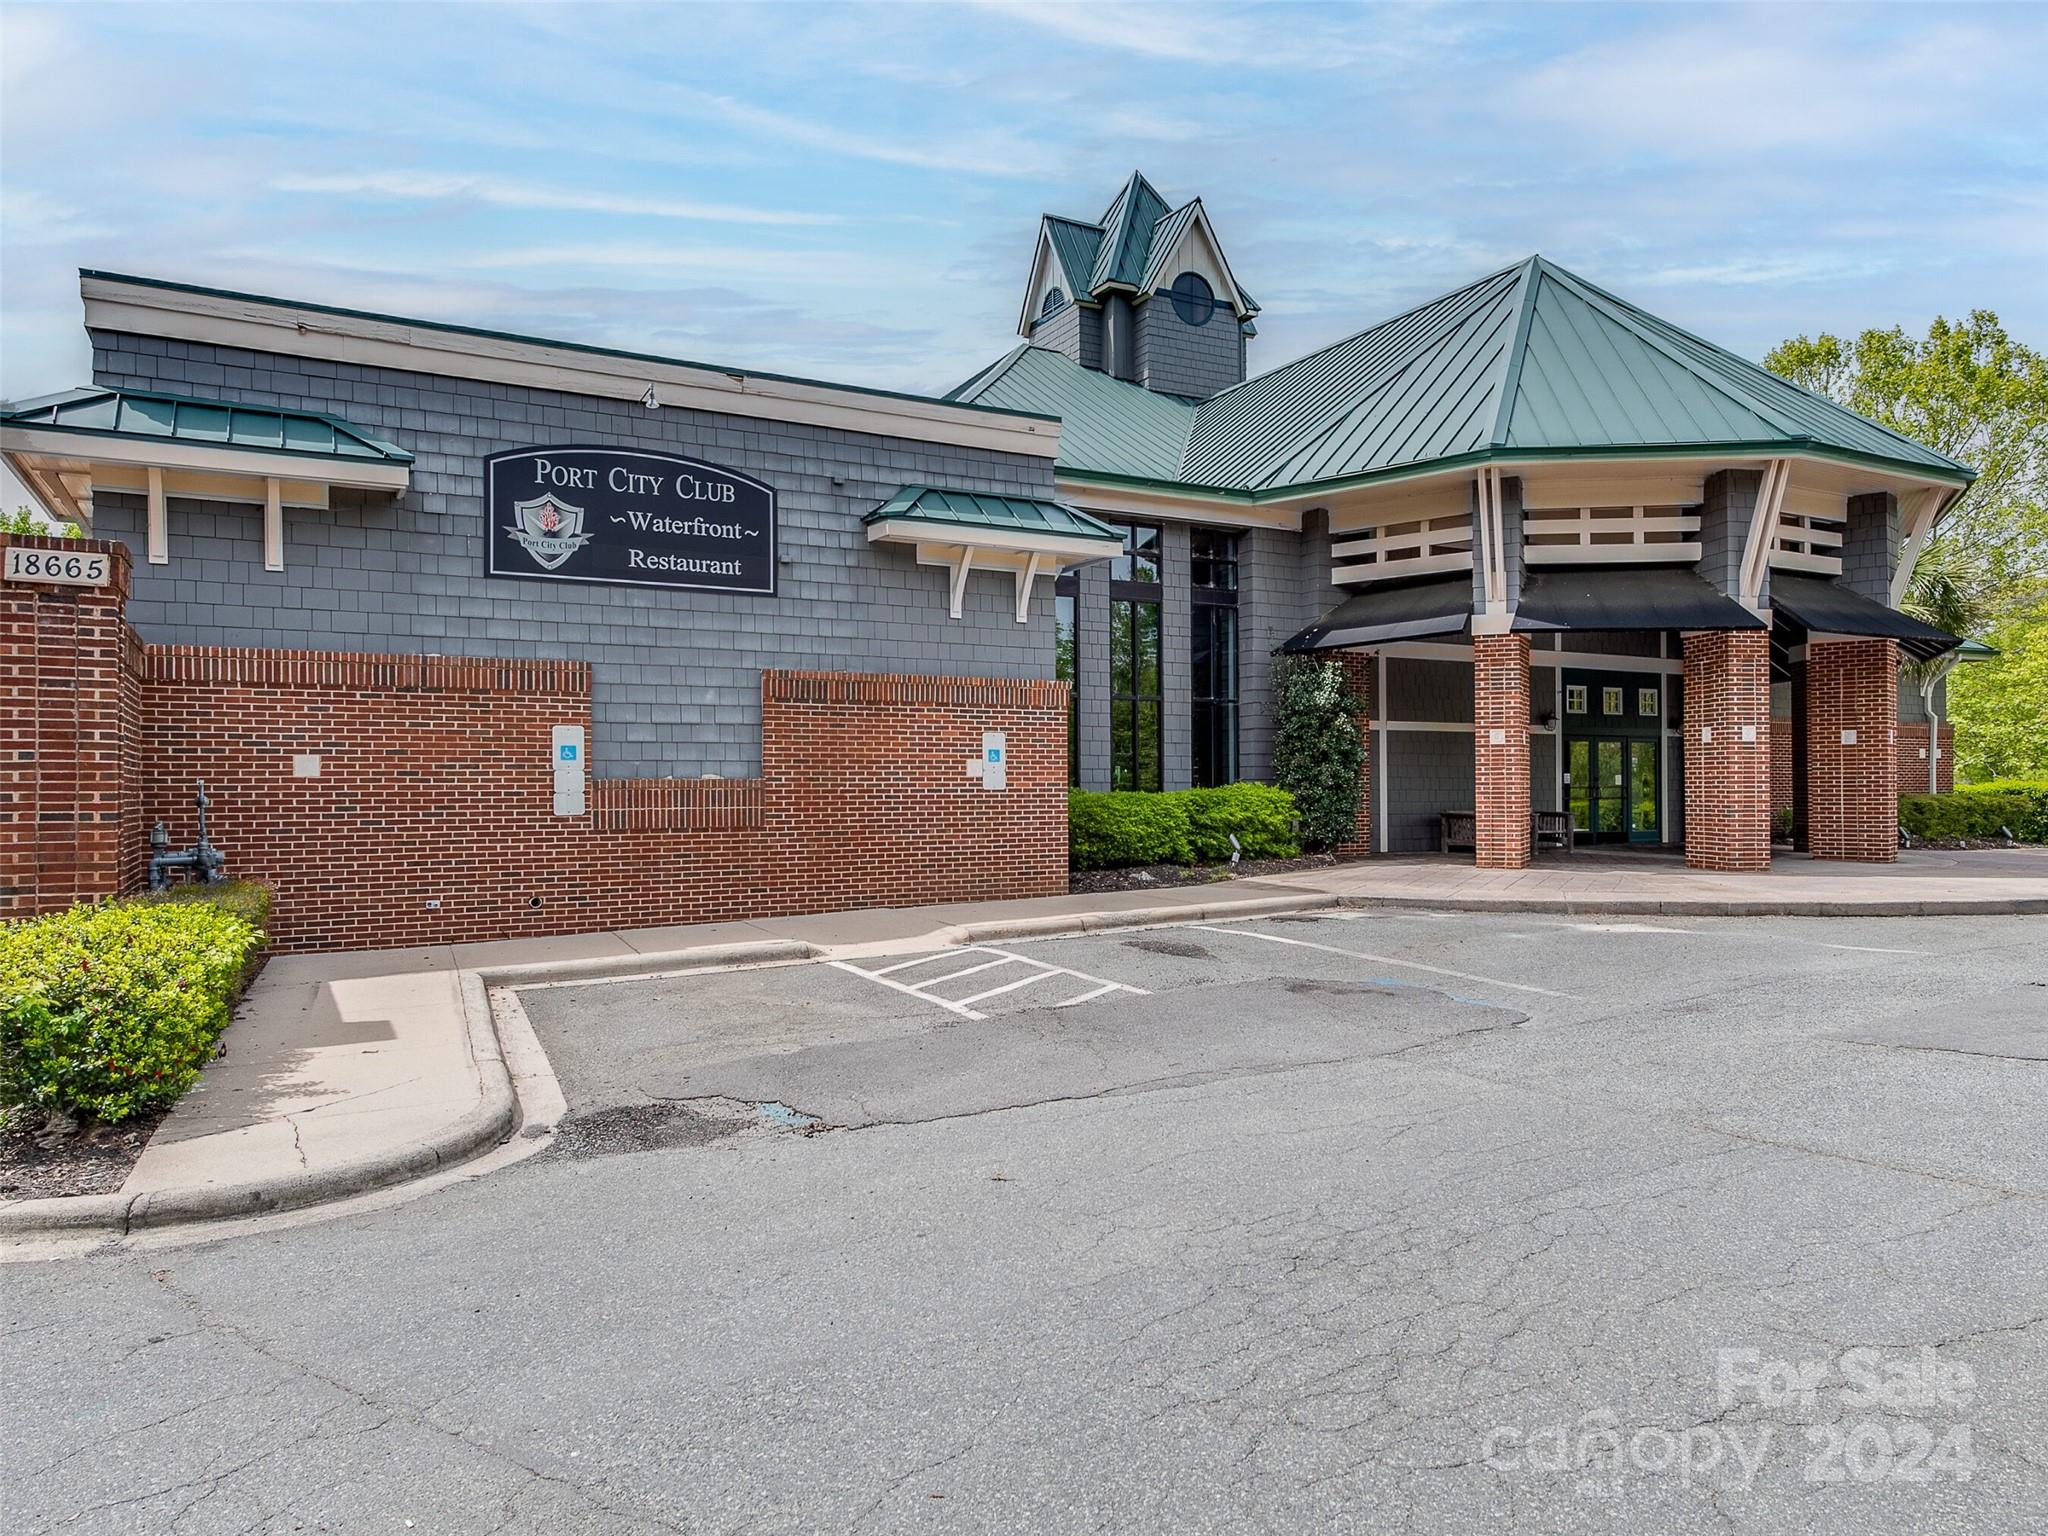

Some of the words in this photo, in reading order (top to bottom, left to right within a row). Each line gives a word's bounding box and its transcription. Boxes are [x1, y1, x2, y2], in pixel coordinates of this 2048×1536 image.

[534, 458, 598, 489] PORT
[608, 467, 664, 496] CITY
[675, 474, 736, 503] CLUB
[522, 537, 539, 547] Port
[541, 540, 556, 551] City
[559, 541, 577, 550] Club
[13, 553, 103, 579] 18665
[627, 548, 742, 576] Restaurant
